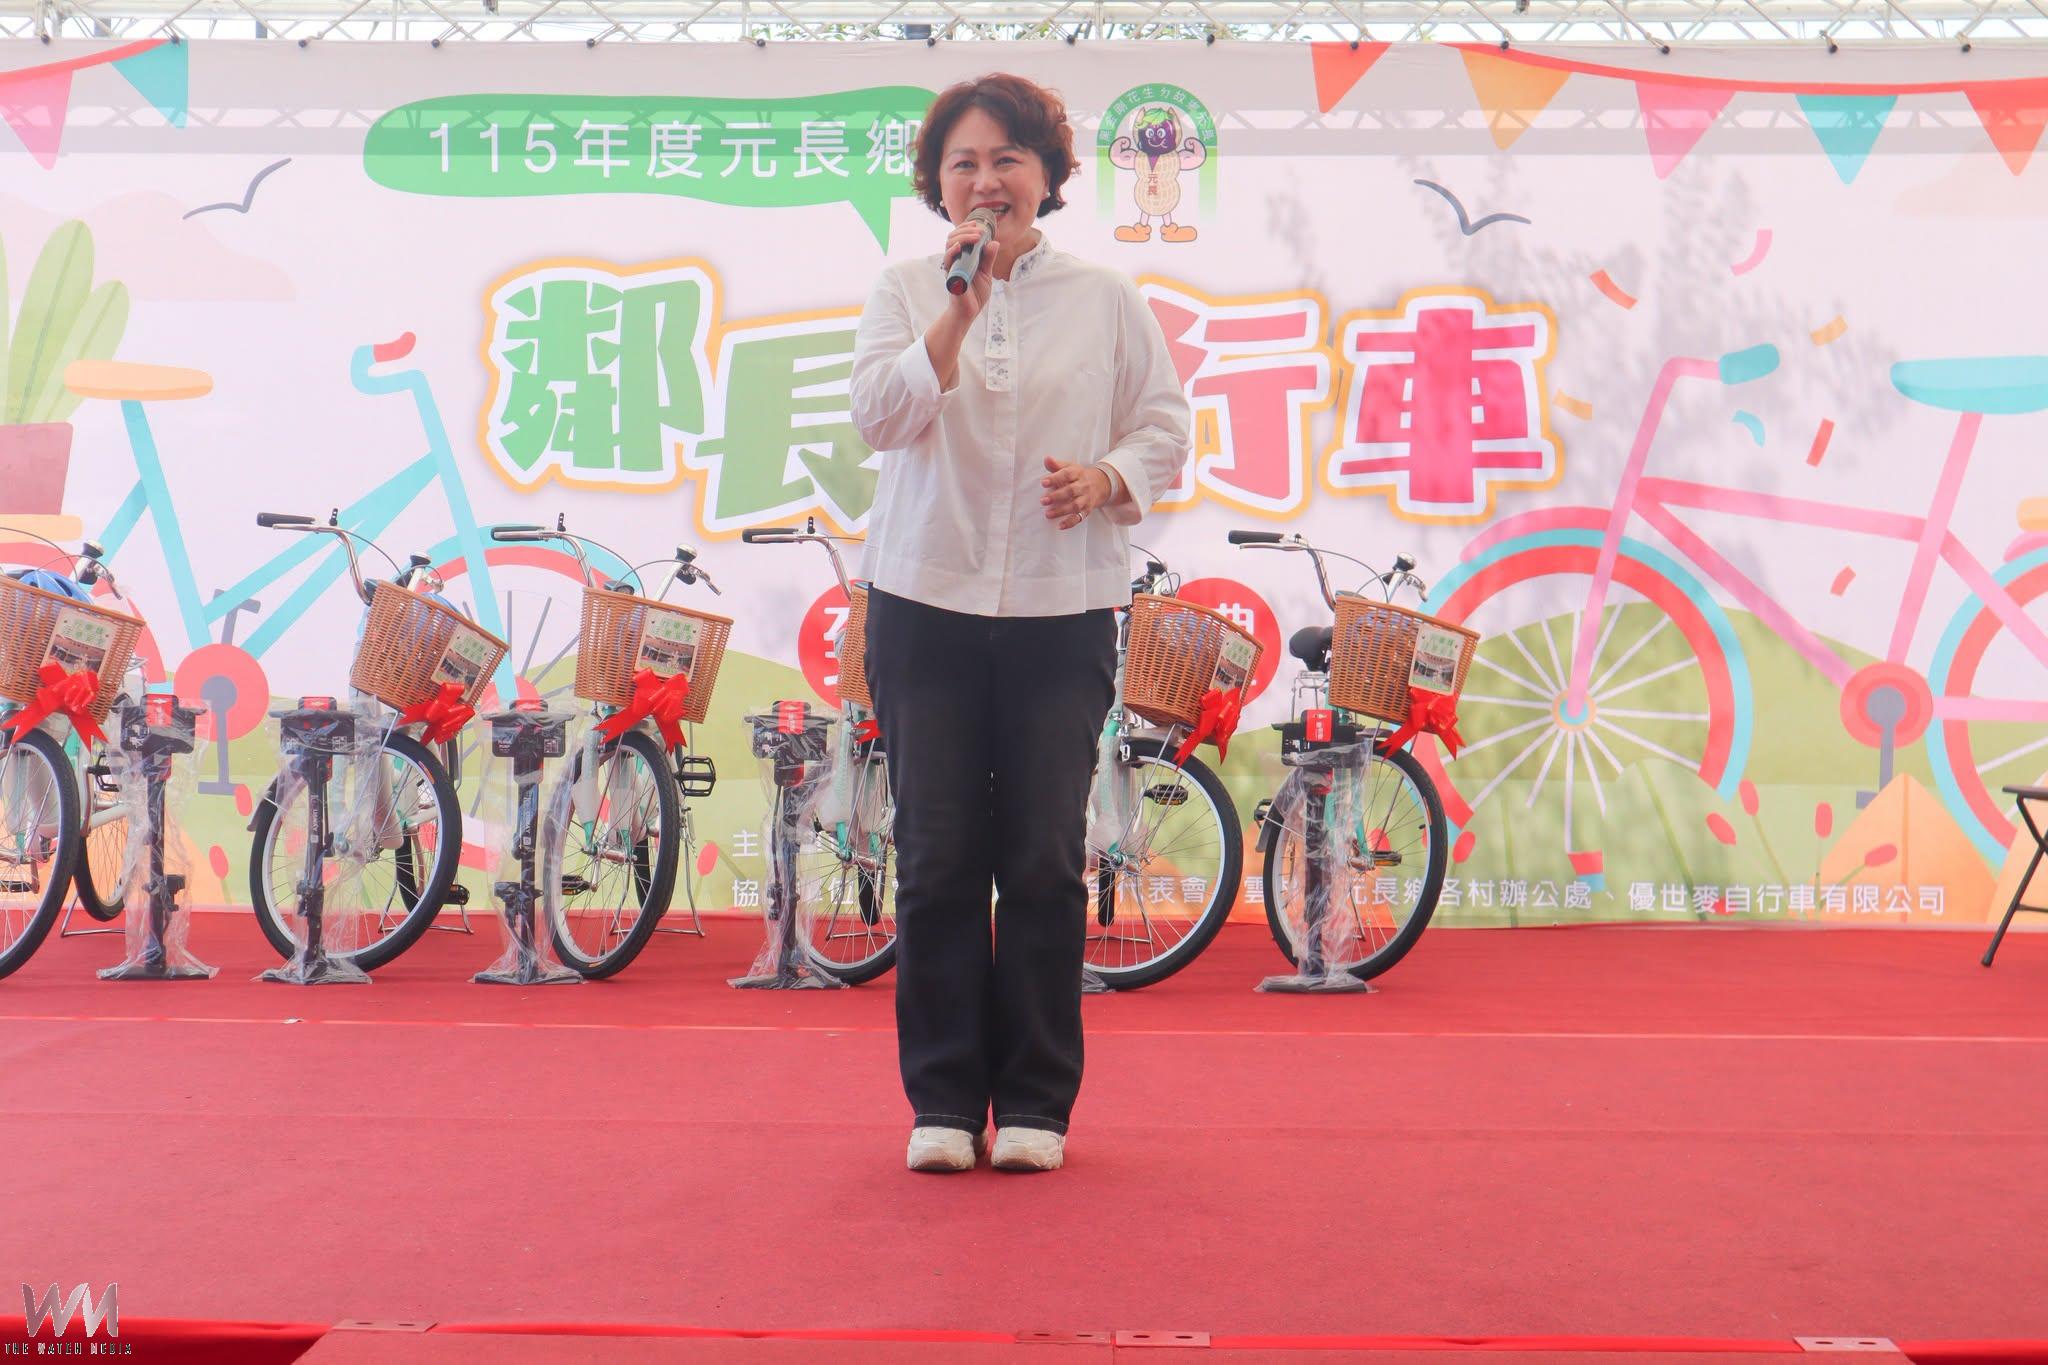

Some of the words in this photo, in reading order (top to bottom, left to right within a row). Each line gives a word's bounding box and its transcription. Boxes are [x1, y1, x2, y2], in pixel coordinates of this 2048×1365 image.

[429, 119, 922, 178] 115年度元長鄉
